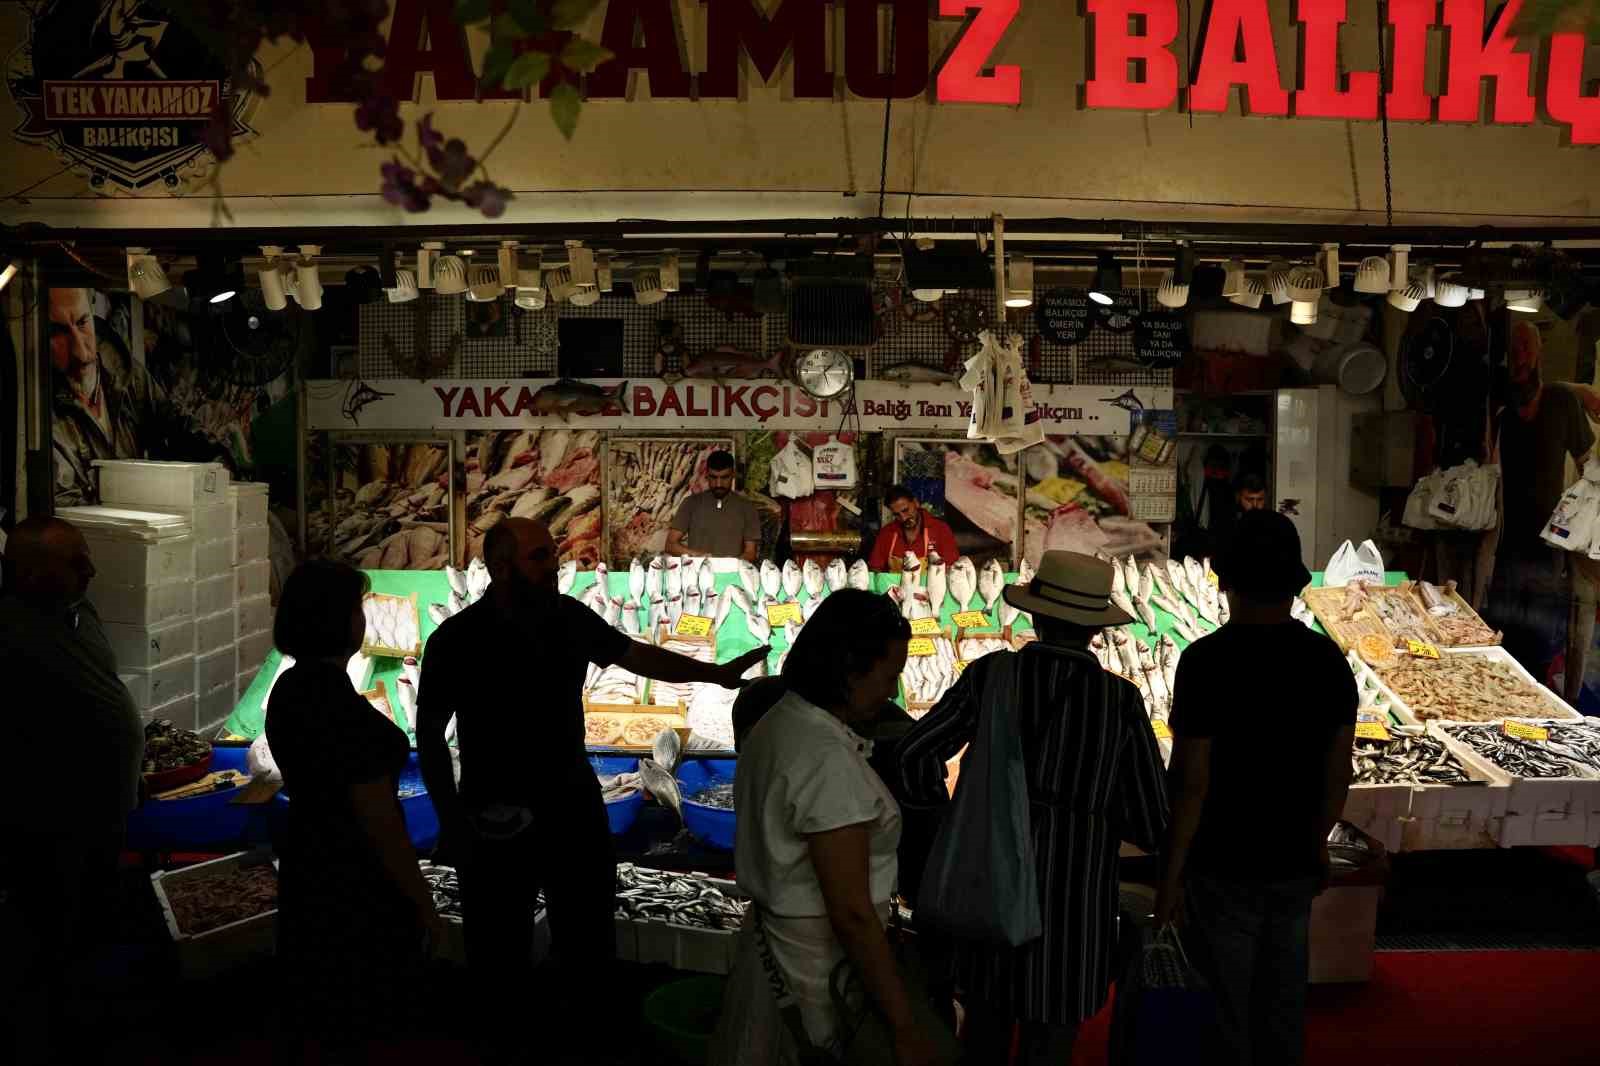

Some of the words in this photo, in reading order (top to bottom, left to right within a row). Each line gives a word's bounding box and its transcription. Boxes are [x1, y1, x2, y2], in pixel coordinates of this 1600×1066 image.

[51, 86, 97, 115] TEK
[99, 85, 213, 116] YAKAMOZ
[433, 386, 622, 417] YAKAZ
[633, 386, 829, 422] BALIKÇISI
[916, 400, 952, 417] Tanı
